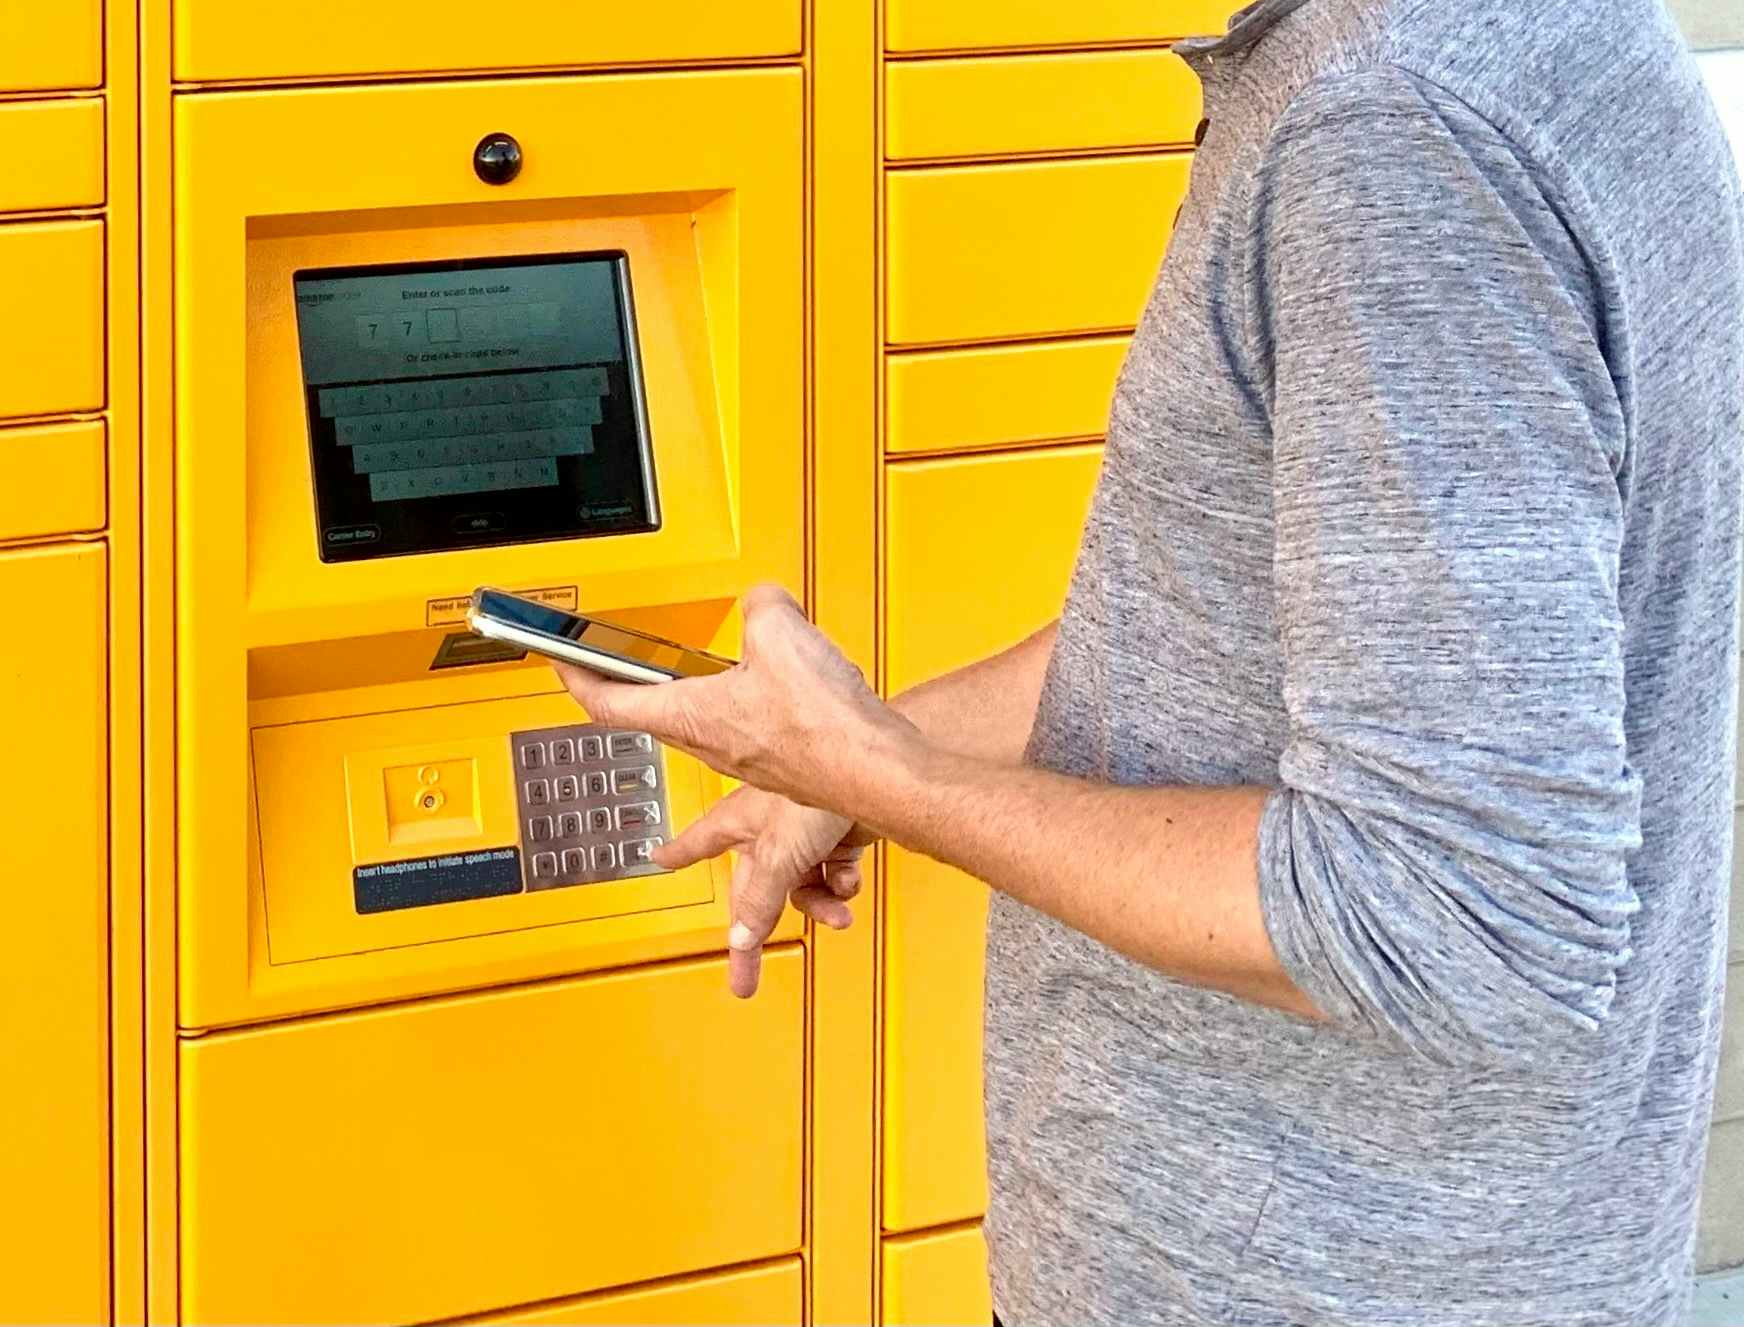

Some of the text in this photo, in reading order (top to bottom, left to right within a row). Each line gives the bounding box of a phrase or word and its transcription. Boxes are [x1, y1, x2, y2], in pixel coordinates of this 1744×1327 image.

[401, 289, 428, 300] Enter
[367, 320, 413, 340] 7 7
[530, 749, 537, 762] 1
[558, 745, 568, 760] 2
[587, 742, 596, 756] 3
[534, 785, 543, 799] 4
[562, 782, 572, 796] 5
[591, 778, 601, 793] 6
[537, 813, 604, 834] 7 8 9
[381, 861, 428, 875] headphones
[465, 852, 492, 866] speech
[493, 849, 515, 860] mode
[569, 853, 579, 866] 0
